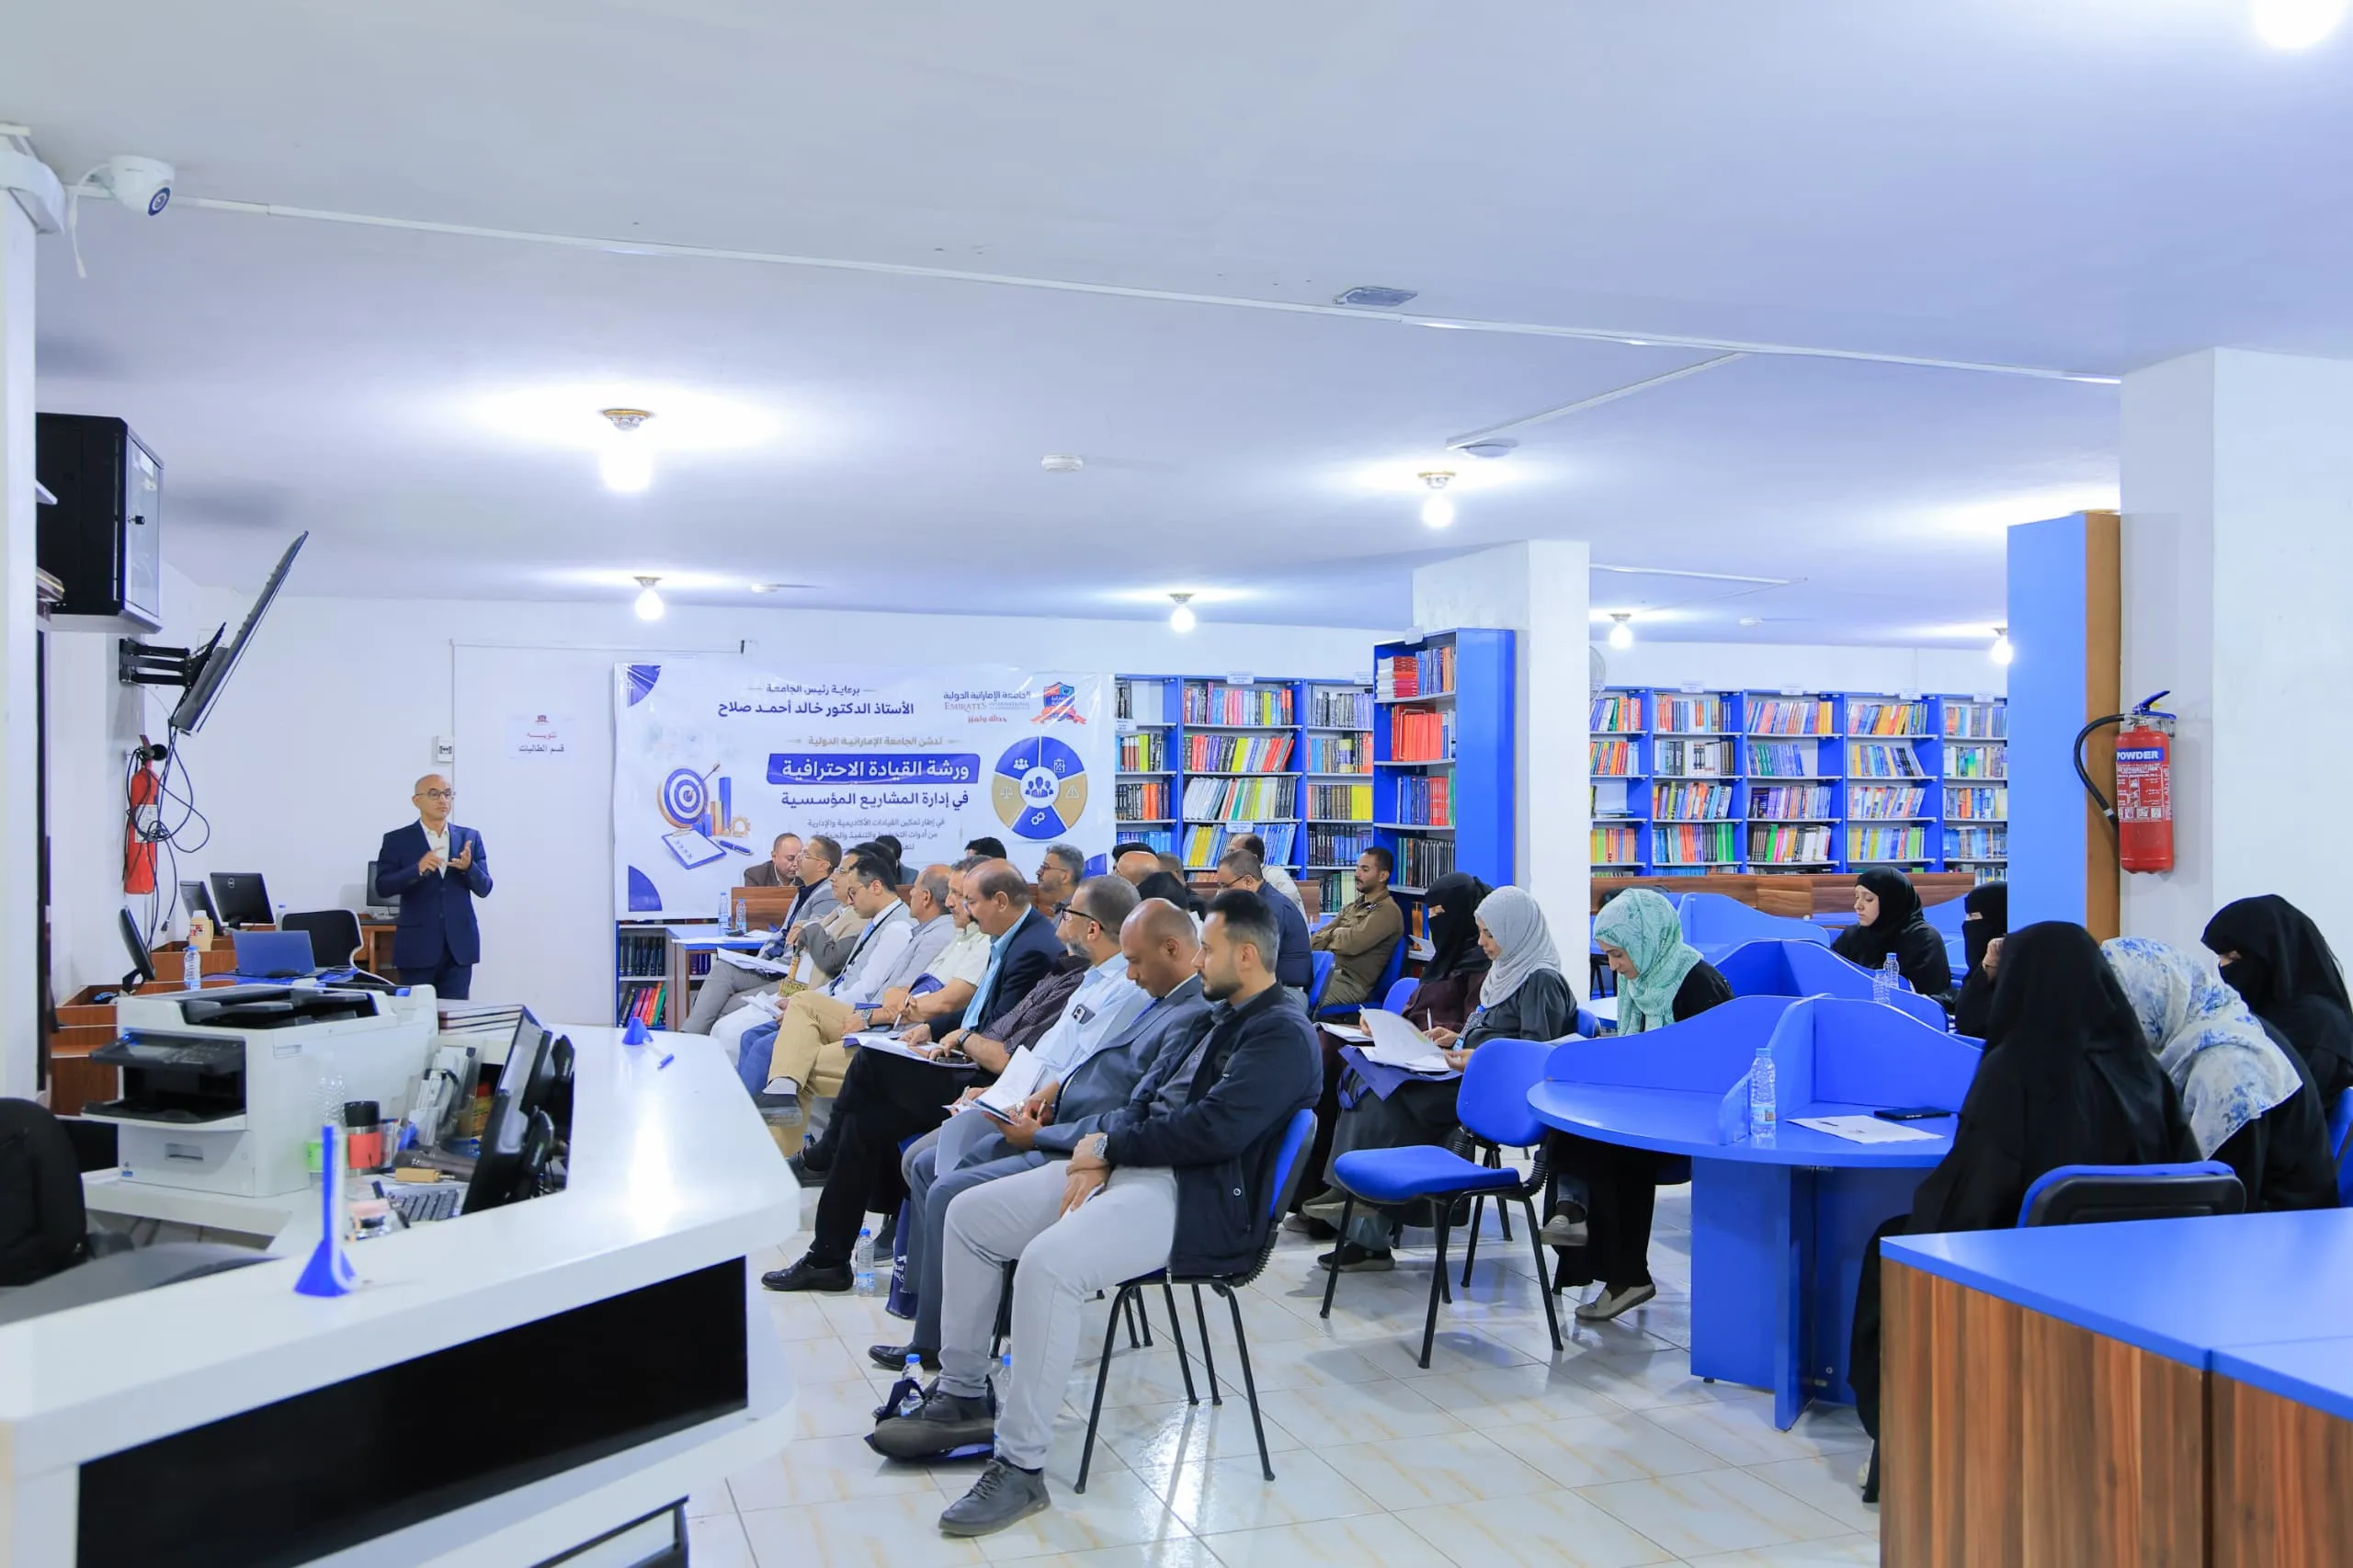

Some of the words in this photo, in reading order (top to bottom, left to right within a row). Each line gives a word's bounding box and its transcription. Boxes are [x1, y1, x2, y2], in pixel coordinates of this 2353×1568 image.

[766, 683, 802, 694] الجامعة
[803, 684, 830, 697] رئيس
[717, 700, 752, 718] صلاح
[755, 699, 791, 715] أحمد
[794, 701, 824, 715] خالد
[824, 701, 871, 718] الدكتور
[873, 700, 915, 715] الأستاذ
[944, 701, 987, 713] EMIRATES
[808, 736, 839, 748] الدولية
[883, 736, 917, 747] الجامعة
[2117, 750, 2159, 761] POWDER
[781, 758, 865, 781] الاحترافية
[868, 760, 922, 781] القيادة
[926, 759, 970, 780] ورشة
[780, 791, 857, 809] المؤسسية
[859, 791, 919, 810] المشاريع
[921, 791, 949, 809] إدارة
[951, 790, 969, 812] في
